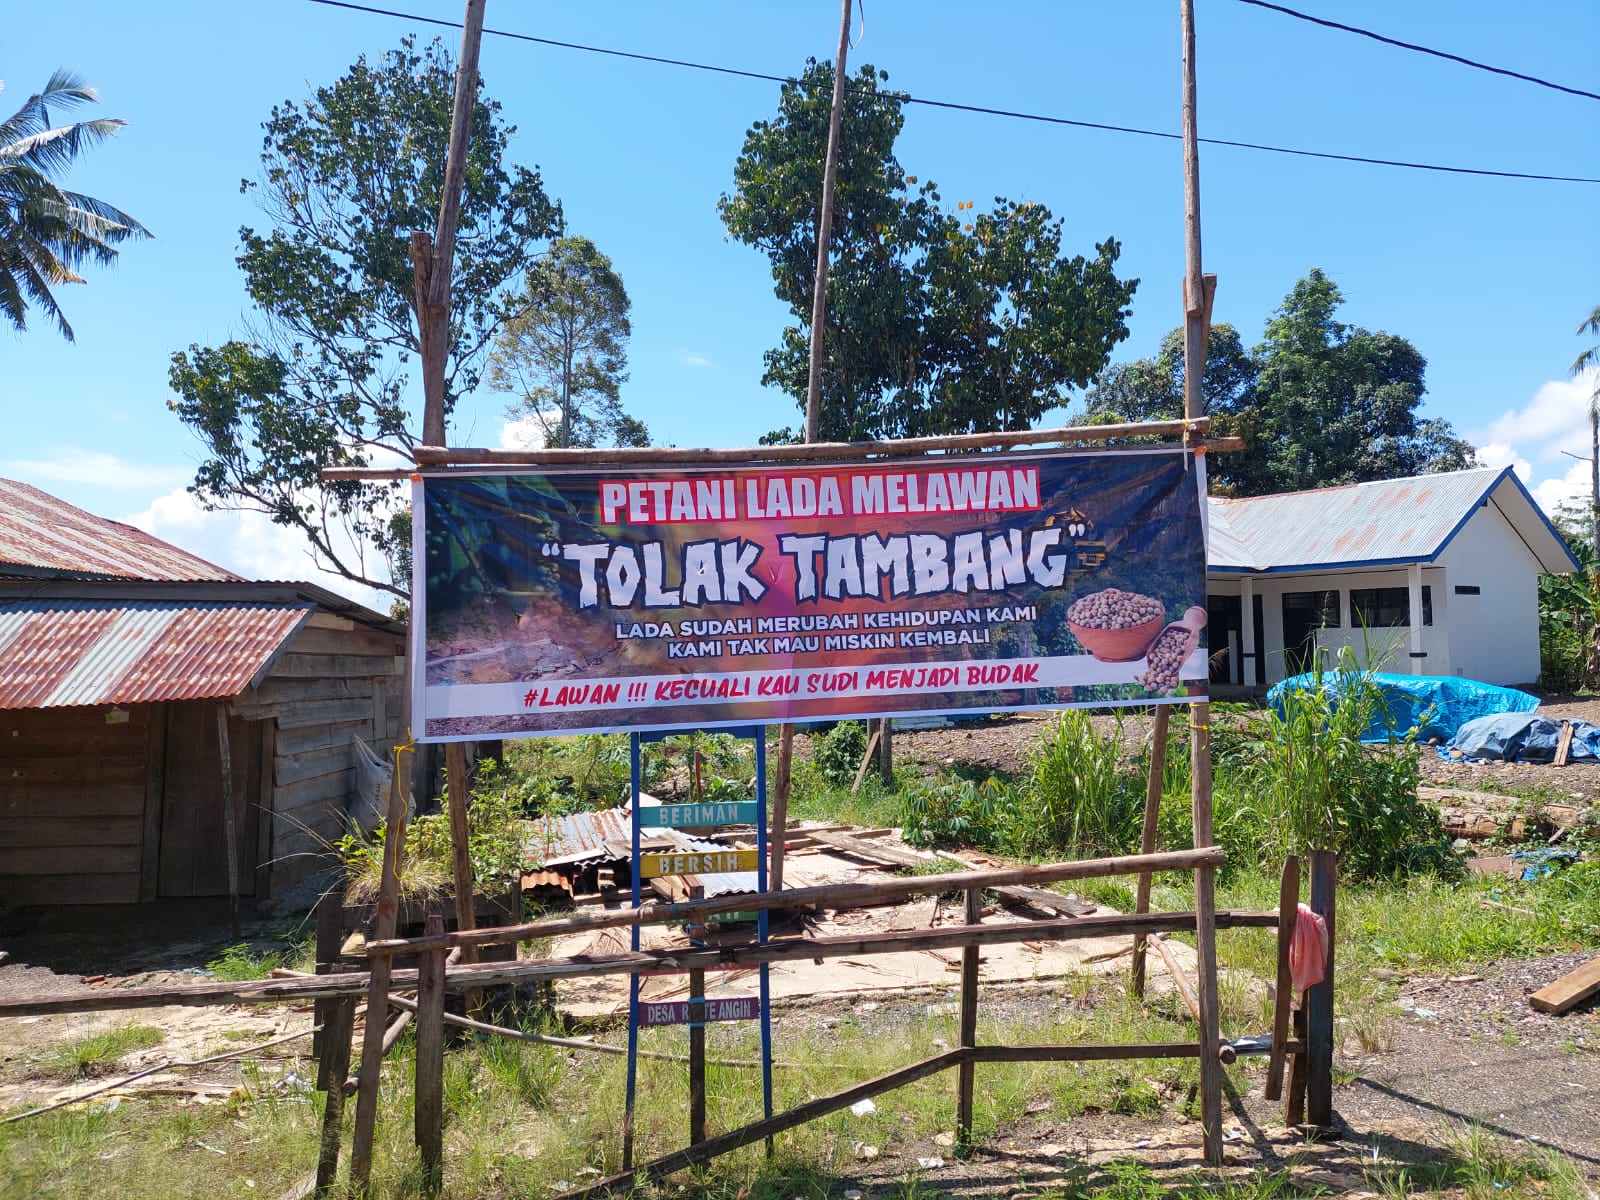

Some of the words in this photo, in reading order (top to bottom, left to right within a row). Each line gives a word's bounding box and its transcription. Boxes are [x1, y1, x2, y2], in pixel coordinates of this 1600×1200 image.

[603, 480, 736, 523] PETANI
[747, 477, 844, 518] LADA
[852, 469, 1037, 513] MELAWAN
[616, 621, 674, 639] LADA
[680, 618, 752, 636] SUDAH
[758, 613, 858, 633] MERUBAH
[864, 608, 981, 628] KEHIDUPAN
[987, 605, 1036, 622] KAMI
[669, 641, 721, 658] KAMI
[728, 638, 767, 655] TAK
[775, 636, 819, 653] MAU
[826, 631, 894, 650] MISKIN
[901, 628, 990, 647] KEMBALI
[524, 683, 620, 708] #LAWAN
[628, 682, 648, 703] !!!
[655, 677, 750, 701] KECUALI
[758, 673, 799, 696] KAU
[807, 671, 858, 693] SUDI
[866, 666, 959, 690] MENJADI
[967, 663, 1040, 686] BUDAK
[659, 805, 738, 825] BERIMAN
[659, 854, 738, 874] BERSIH
[648, 1004, 675, 1022] DESA
[682, 1002, 716, 1020] RTE
[718, 1000, 751, 1019] ANGIN
